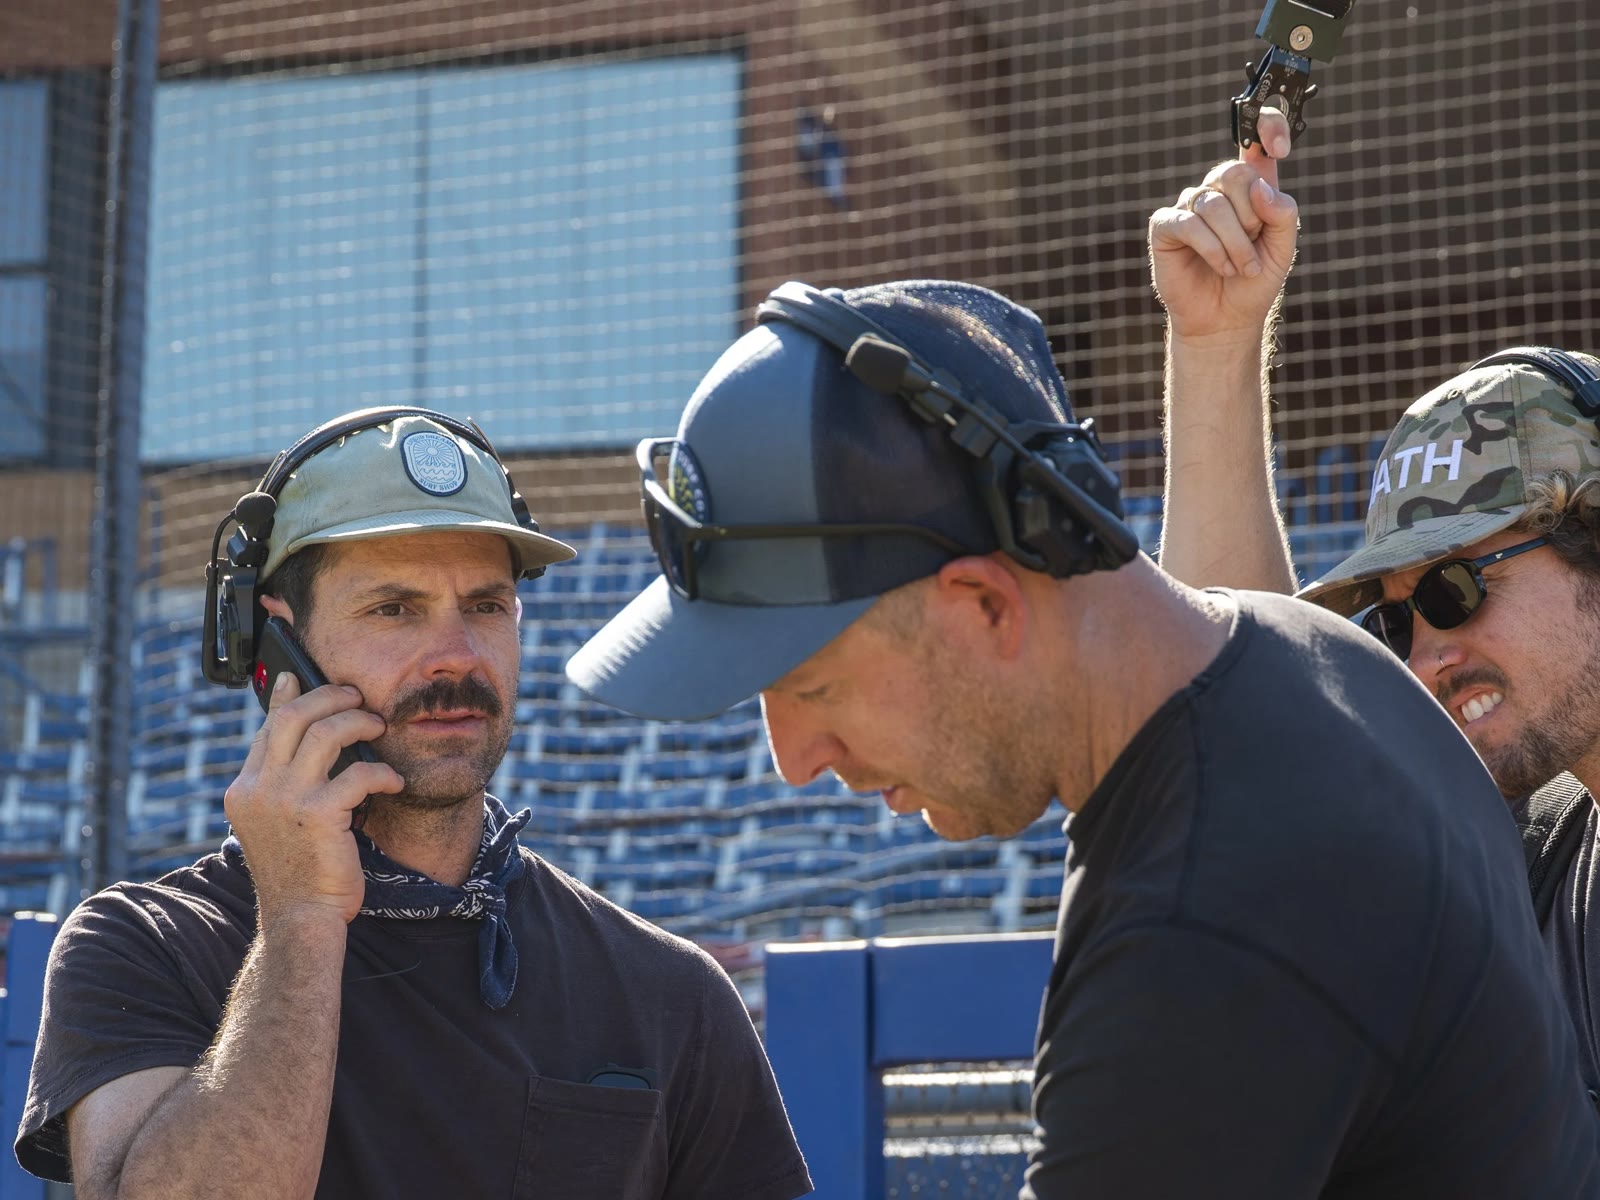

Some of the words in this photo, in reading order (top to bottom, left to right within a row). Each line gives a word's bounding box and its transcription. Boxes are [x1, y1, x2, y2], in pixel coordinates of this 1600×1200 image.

[420, 478, 437, 490] SURF
[439, 480, 458, 491] SHOP
[1368, 439, 1464, 511] ATH
